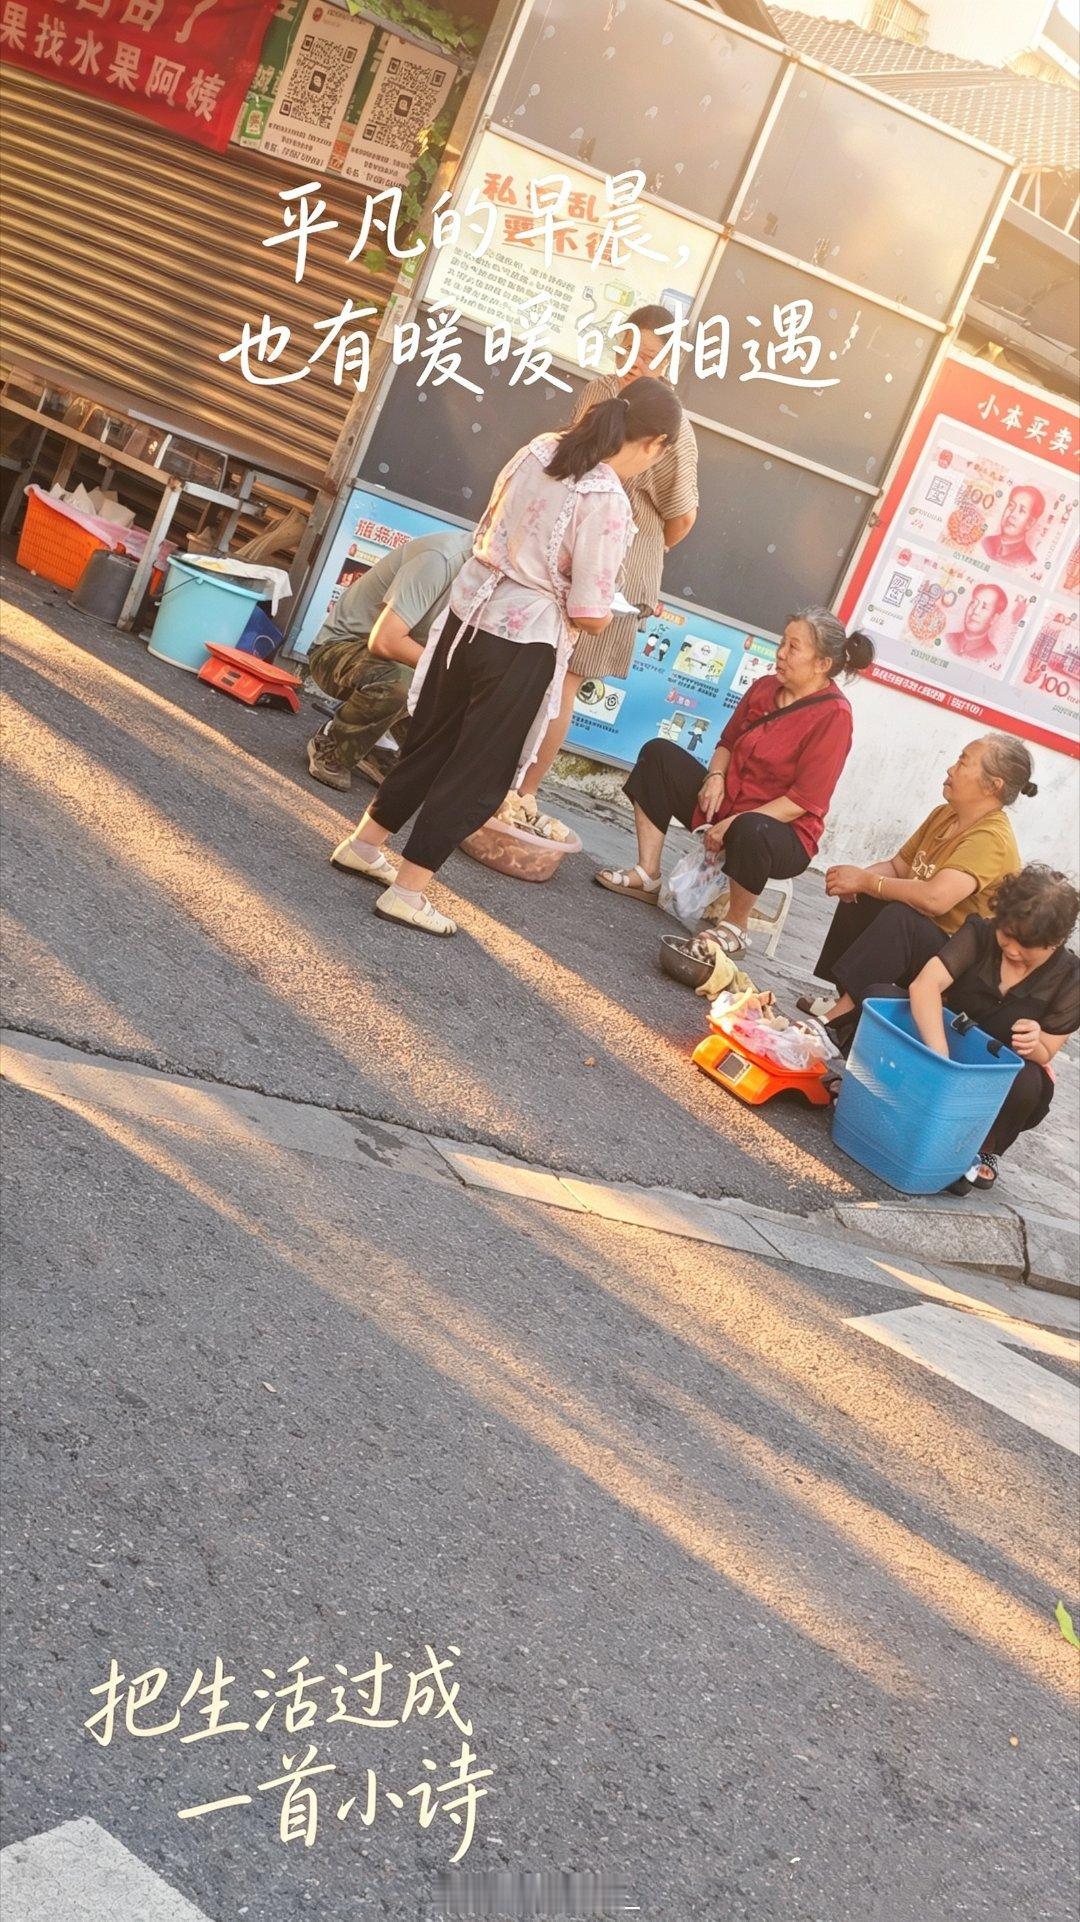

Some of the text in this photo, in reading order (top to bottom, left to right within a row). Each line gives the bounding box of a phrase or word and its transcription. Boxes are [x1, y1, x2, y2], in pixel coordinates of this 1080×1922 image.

[482, 172, 634, 227] 私乱
[977, 393, 1080, 458] 小本买卖
[1038, 671, 1071, 699] 100
